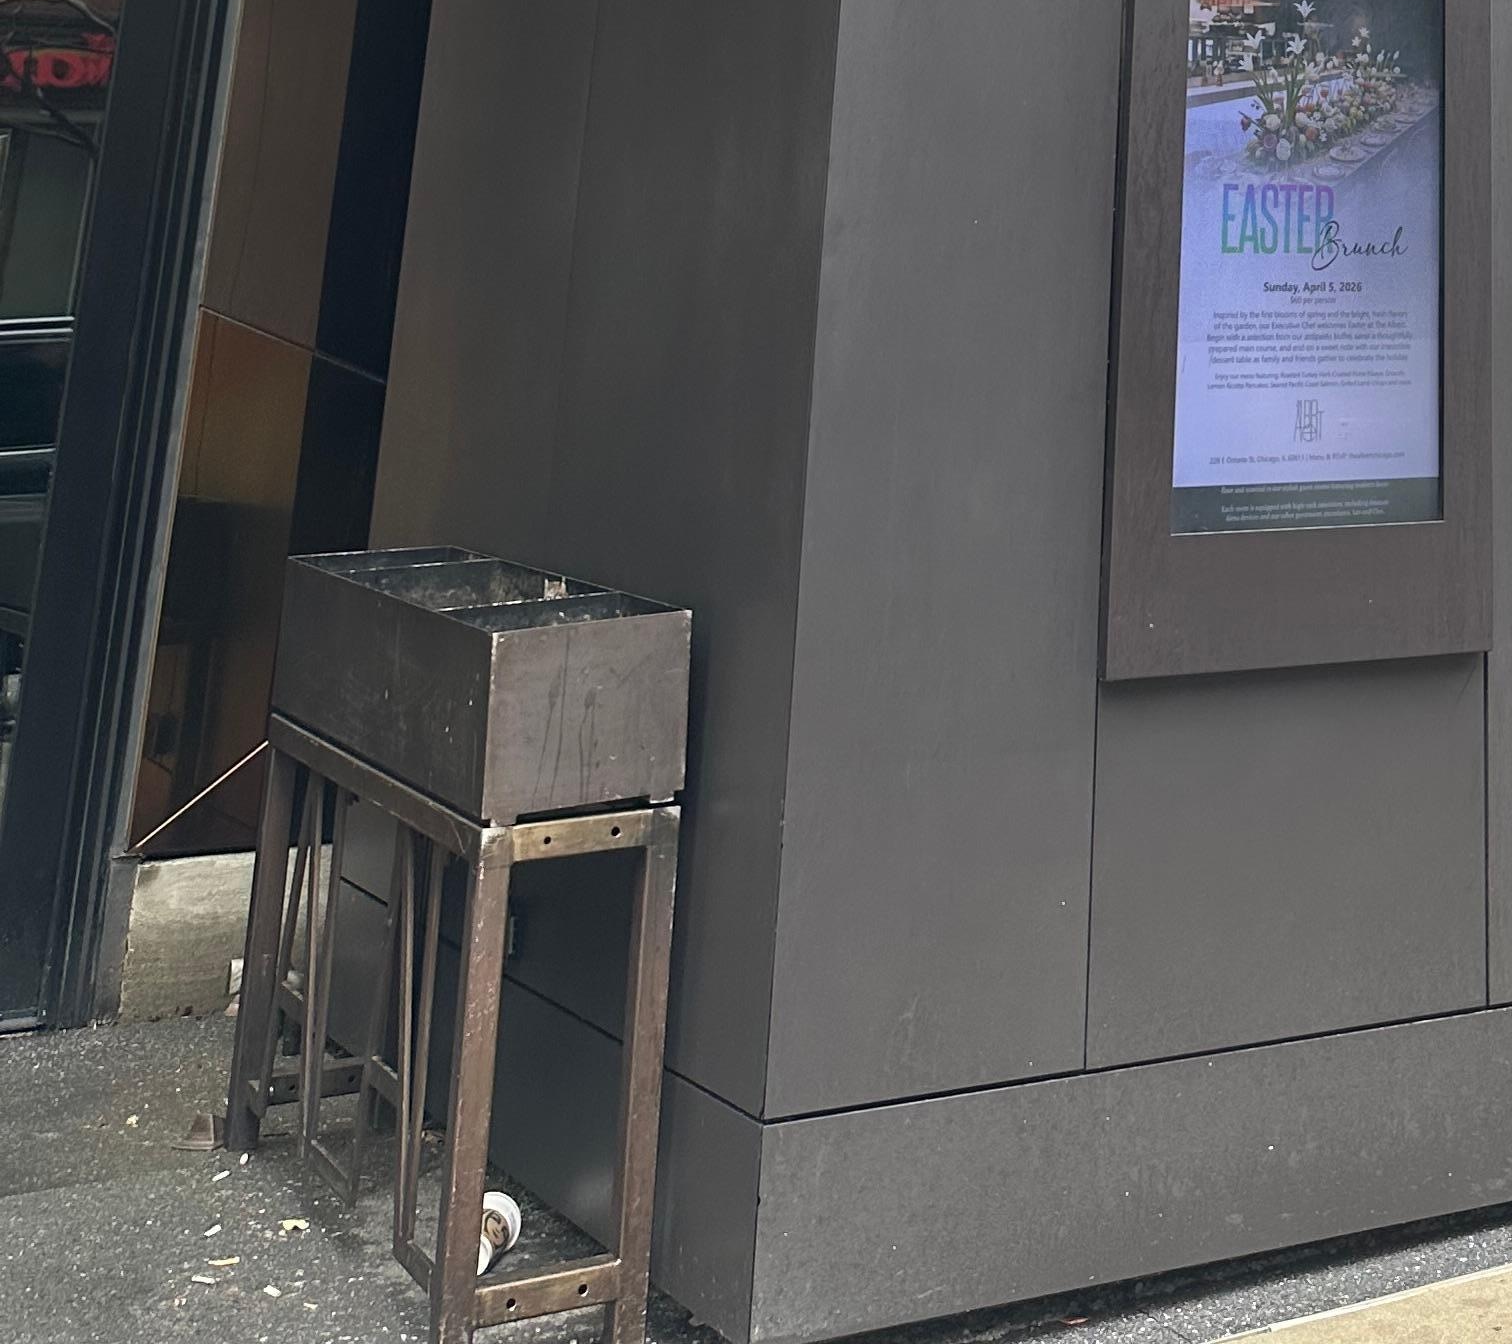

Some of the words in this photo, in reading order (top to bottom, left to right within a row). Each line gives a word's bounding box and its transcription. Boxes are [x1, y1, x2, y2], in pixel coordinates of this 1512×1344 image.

[1220, 183, 1335, 254] EASTER
[1311, 220, 1409, 271] Brunch
[1263, 281, 1300, 295] Sunday,
[1303, 281, 1326, 295] April
[1328, 281, 1337, 293] 5,
[1340, 281, 1362, 292] 2026
